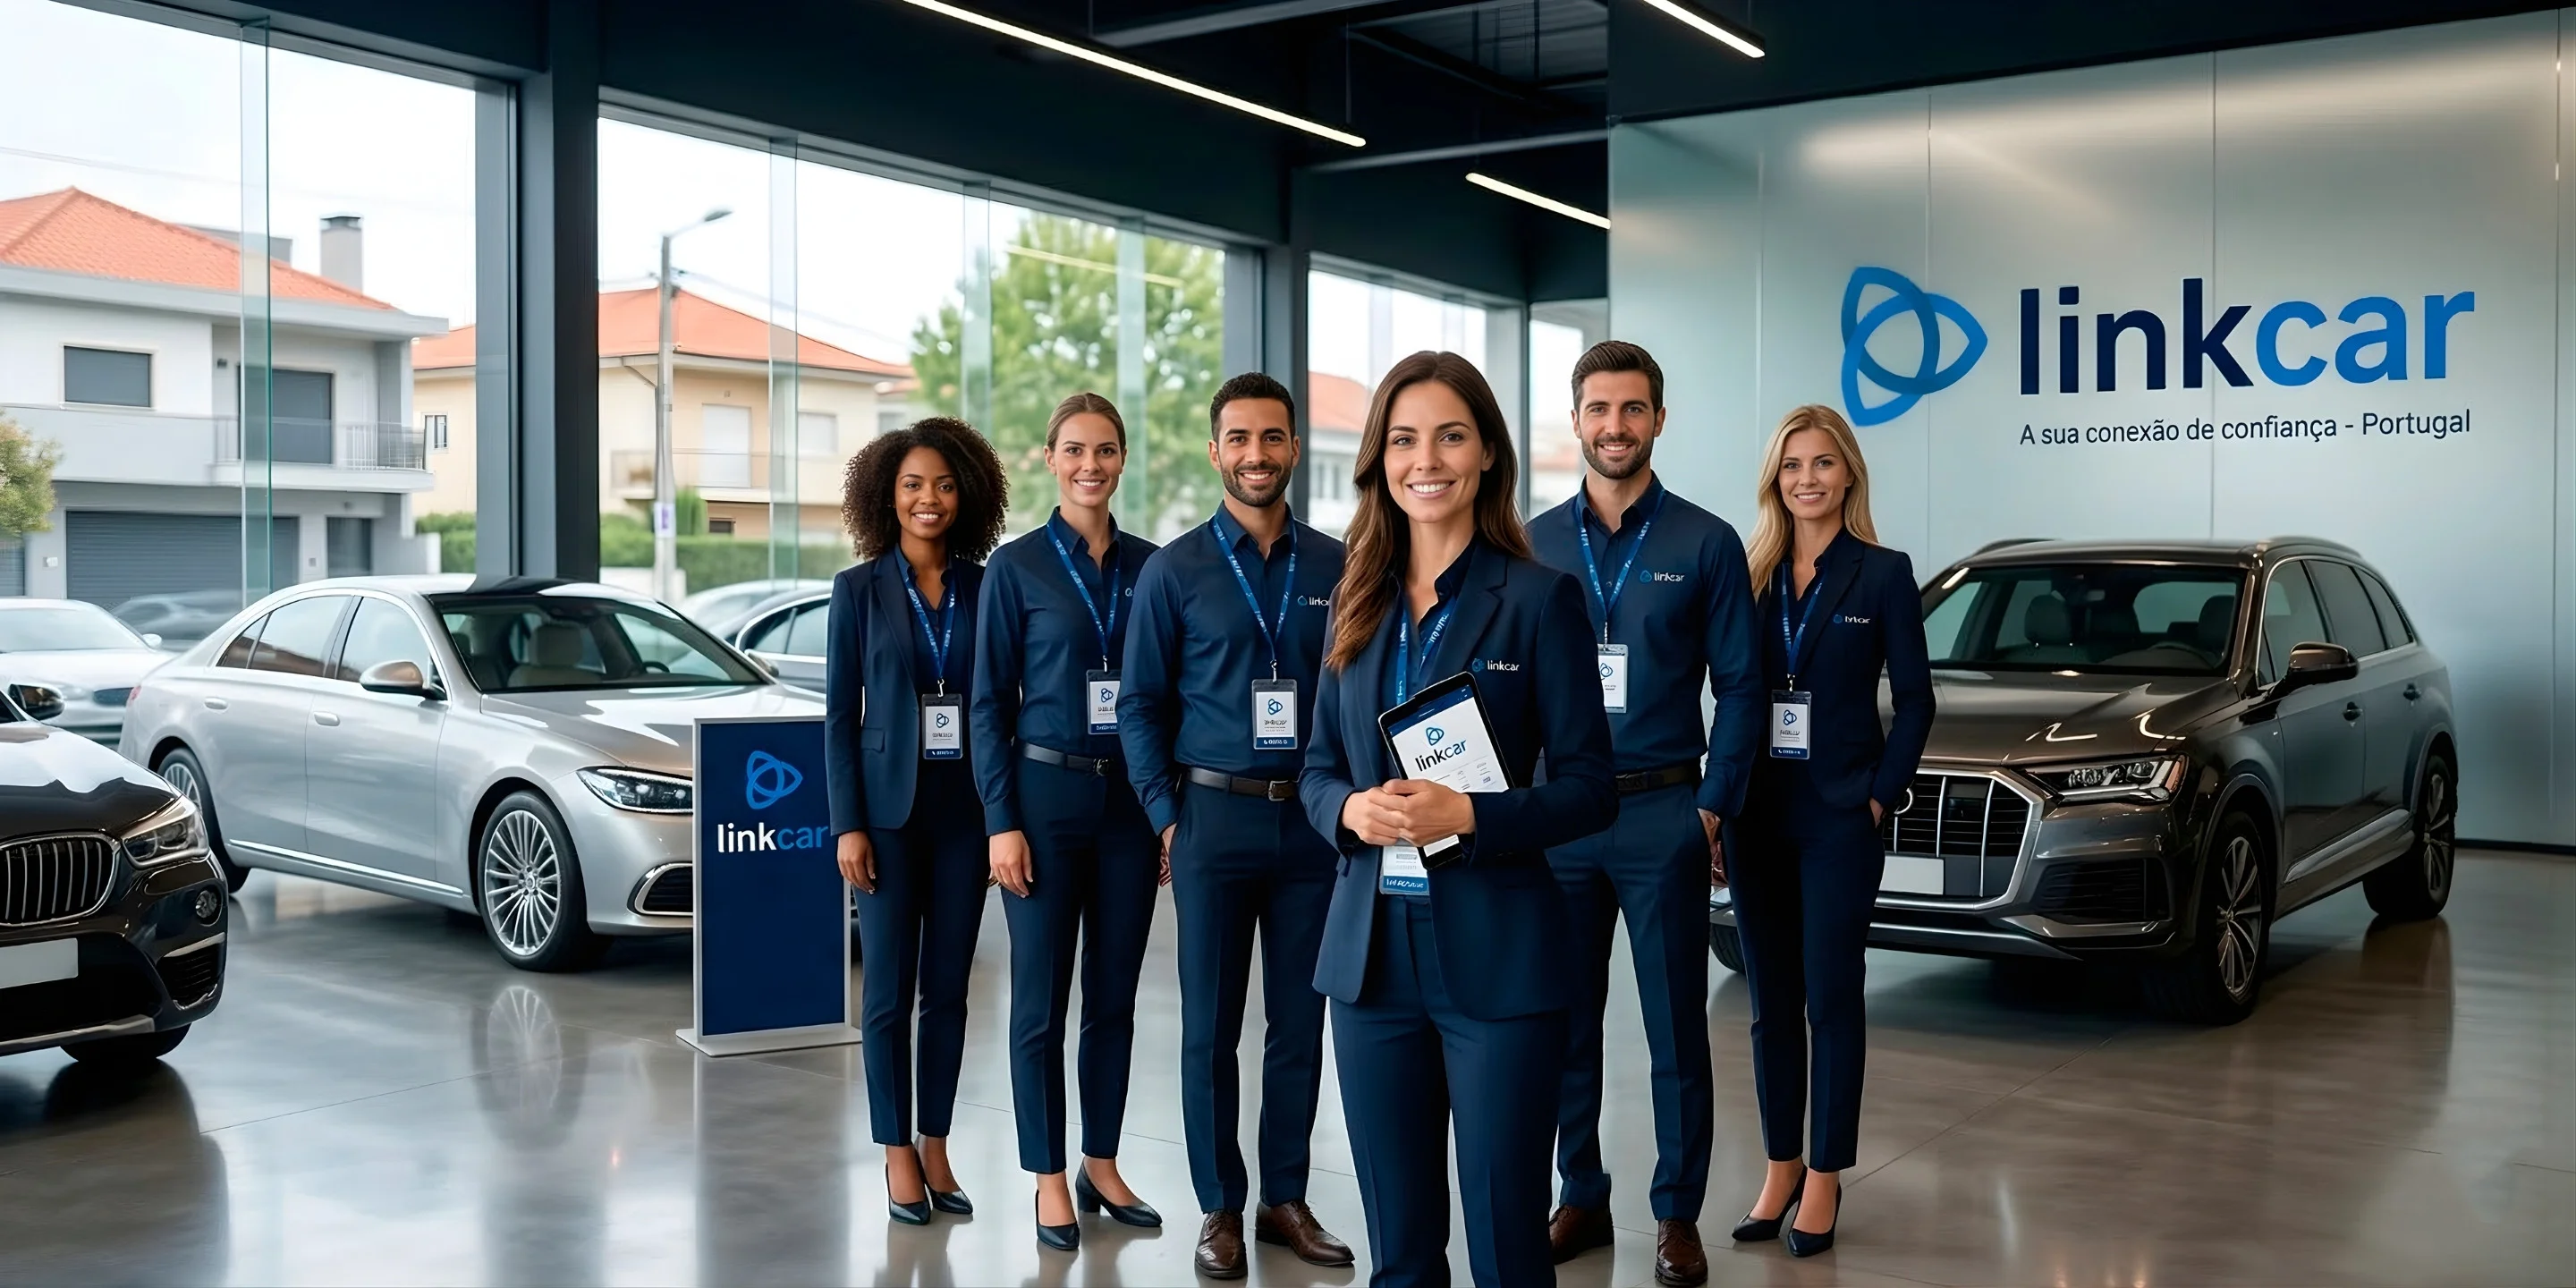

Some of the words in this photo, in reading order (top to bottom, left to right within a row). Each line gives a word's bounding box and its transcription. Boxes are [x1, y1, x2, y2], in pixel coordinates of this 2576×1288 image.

[2020, 277, 2476, 395] linkcar
[2020, 424, 2036, 445] A
[2041, 428, 2079, 445] sua
[2086, 419, 2180, 444] conexão
[2186, 417, 2215, 440] de
[2221, 414, 2337, 445] confiança
[2362, 408, 2470, 440] Portugal
[1487, 660, 1520, 672] linkcar
[1414, 739, 1468, 772] linkcar
[717, 822, 828, 853] linkcar
